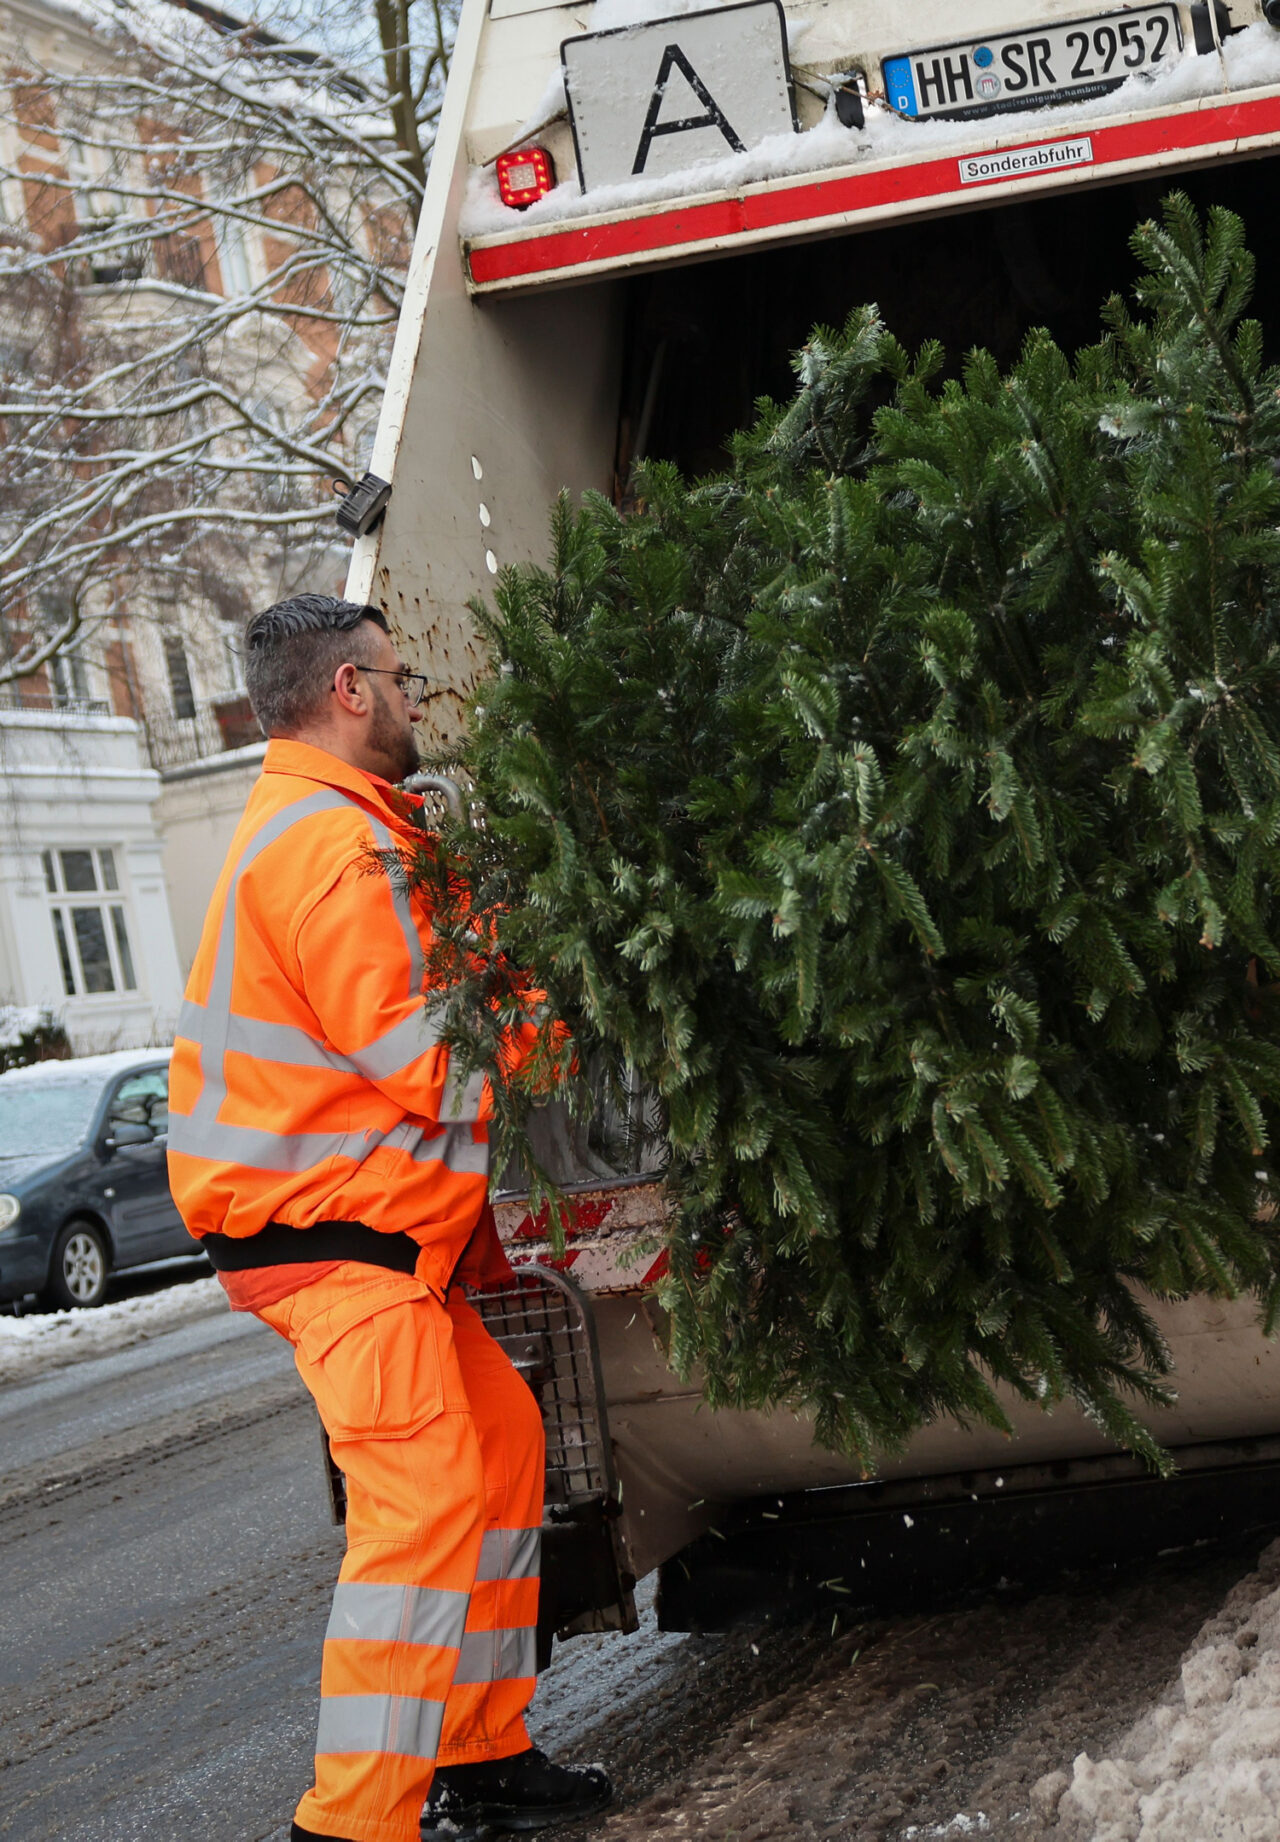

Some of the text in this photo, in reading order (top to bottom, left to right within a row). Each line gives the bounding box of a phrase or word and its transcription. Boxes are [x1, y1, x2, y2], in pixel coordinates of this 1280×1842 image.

[916, 15, 1169, 108] HH SR 2952
[631, 43, 748, 176] A
[898, 95, 908, 109] D
[962, 84, 1108, 117] wwwtadtreinigung.hamburg
[967, 145, 1084, 178] Sonderabfuhr
